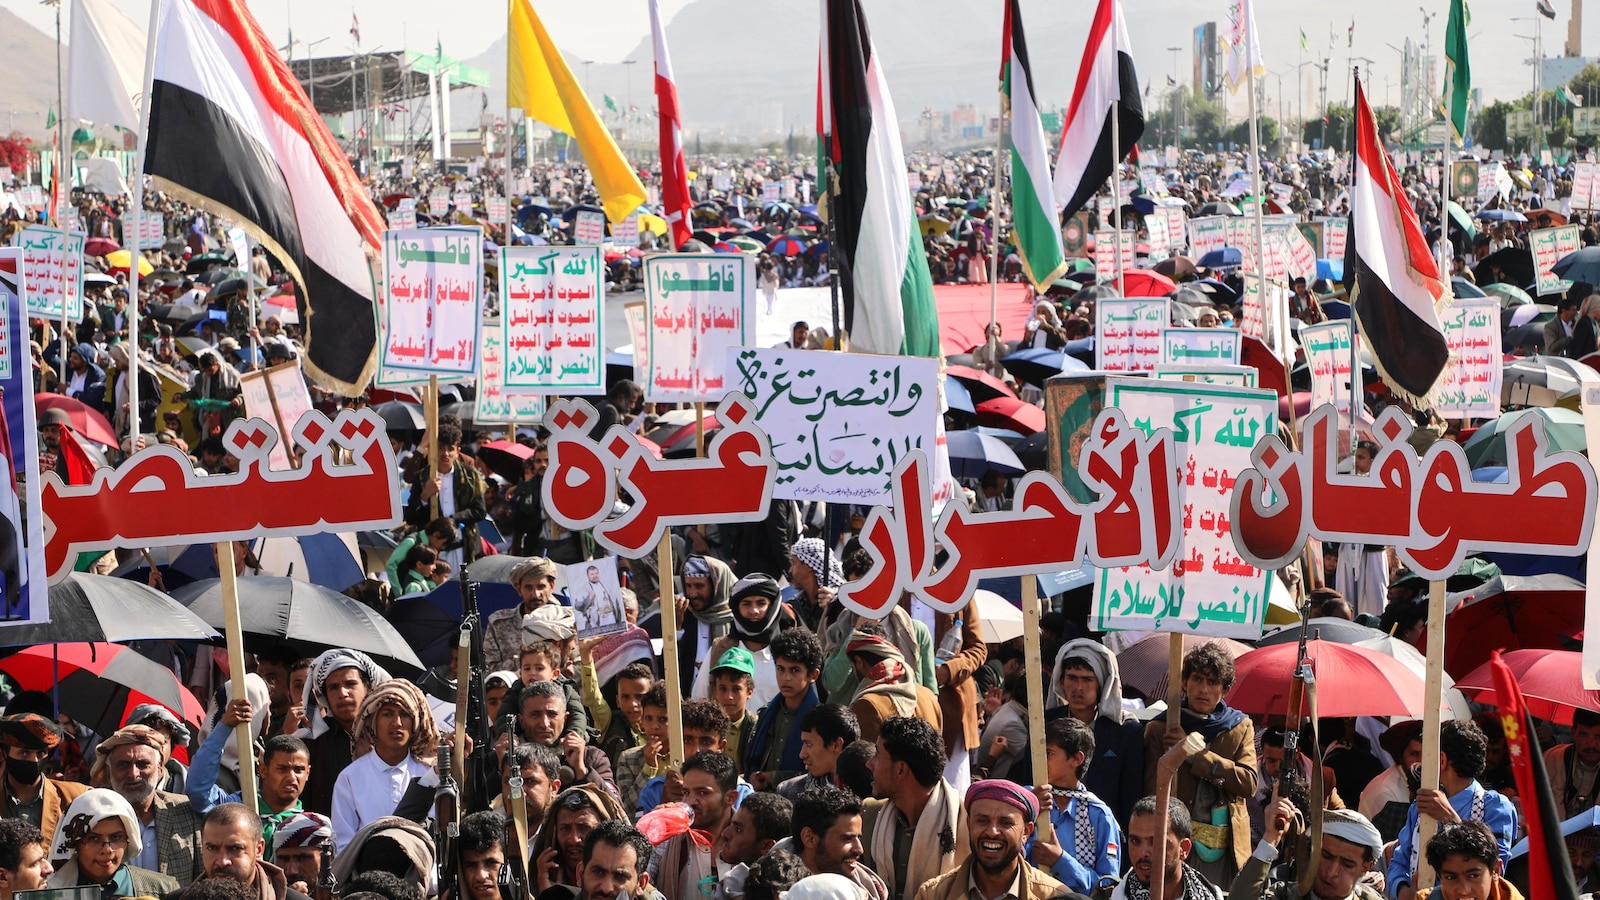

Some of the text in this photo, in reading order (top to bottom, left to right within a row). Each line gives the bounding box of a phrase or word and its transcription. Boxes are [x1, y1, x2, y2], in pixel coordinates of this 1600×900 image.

[394, 233, 471, 269] قاطعوا
[509, 249, 595, 283] الله أكبر
[391, 272, 433, 304] الأمريكية
[436, 277, 475, 307] البضائع
[509, 281, 595, 303] الموت لأمريكا
[656, 263, 734, 299] قاطعوا
[426, 306, 432, 328] و
[509, 308, 595, 328] الموت لإسرائيل
[653, 301, 740, 335] البضائع الأمريكية
[1104, 302, 1163, 327] الله أكبر
[1468, 310, 1492, 327] الله
[389, 334, 473, 366] الإسرائيلية
[509, 331, 595, 351] اللعنة على اليهود
[692, 335, 697, 358] و
[1168, 340, 1233, 362] قاطعوا
[1465, 336, 1493, 349] الموت
[509, 355, 553, 381] للإسلام
[556, 353, 596, 380] النصر
[1466, 353, 1493, 366] الموت
[654, 366, 724, 395] سرائيلية
[1467, 388, 1491, 407] النصر
[42, 400, 1588, 611] طوفان الأحرار غزة تنتصر
[1172, 546, 1204, 578] على
[1107, 579, 1259, 630] النصر للإسلام
